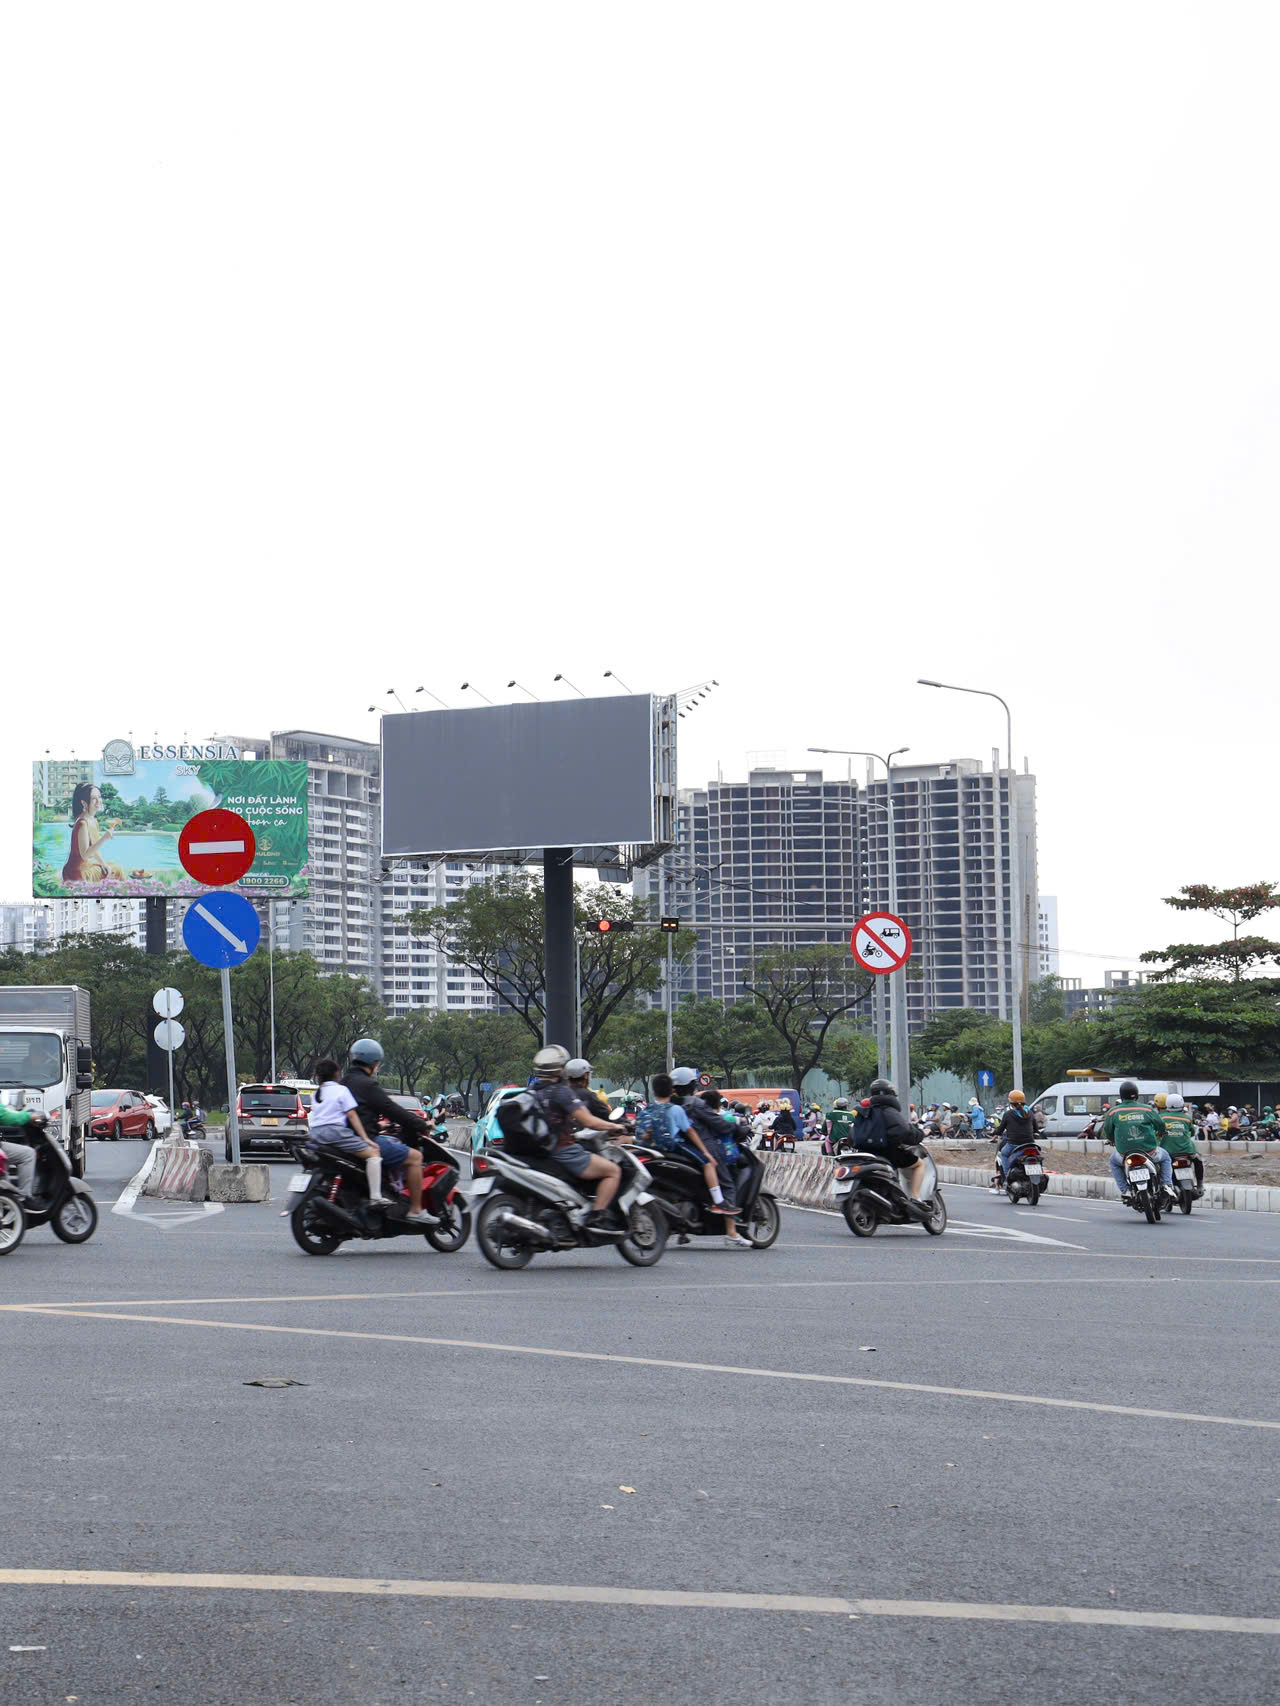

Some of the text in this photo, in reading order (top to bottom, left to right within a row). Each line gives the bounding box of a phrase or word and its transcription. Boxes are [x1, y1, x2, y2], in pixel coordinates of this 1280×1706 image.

[140, 745, 238, 760] ESSENSIA
[176, 765, 201, 776] SKY
[227, 794, 297, 804] NƠI ĐẤT LÀNH
[223, 805, 303, 816] HO CUỘC SỐNG
